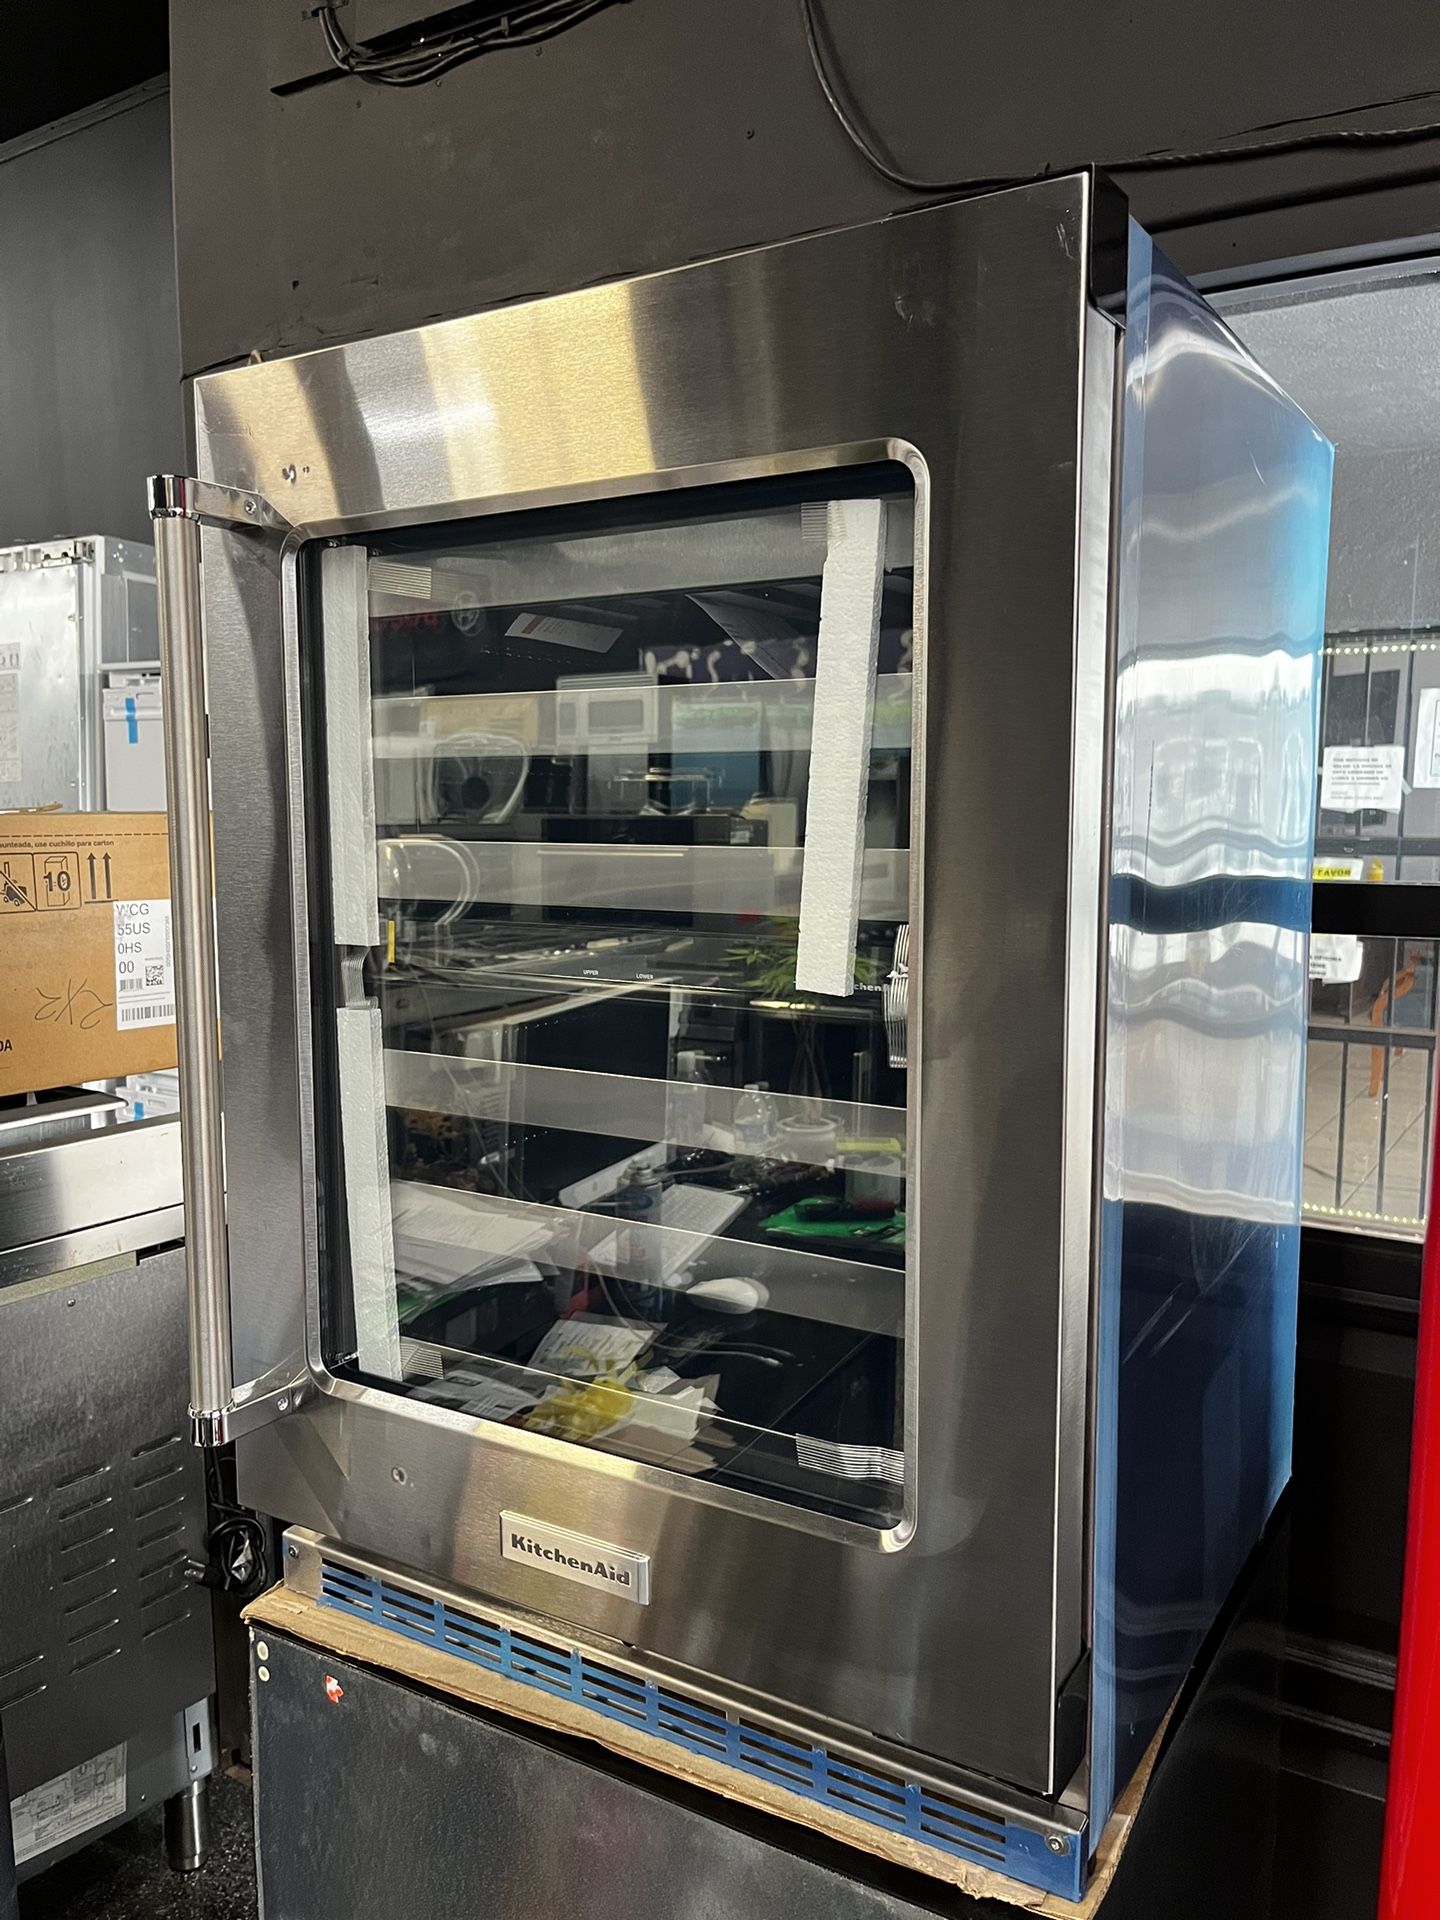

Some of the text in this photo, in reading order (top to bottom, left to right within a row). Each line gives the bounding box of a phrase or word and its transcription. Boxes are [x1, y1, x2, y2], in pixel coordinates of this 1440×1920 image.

[49, 840, 75, 848] cuchillo
[43, 870, 71, 892] 10
[116, 903, 149, 916] WCG
[117, 922, 151, 936] 55US
[511, 1533, 630, 1586] KitchenAid
